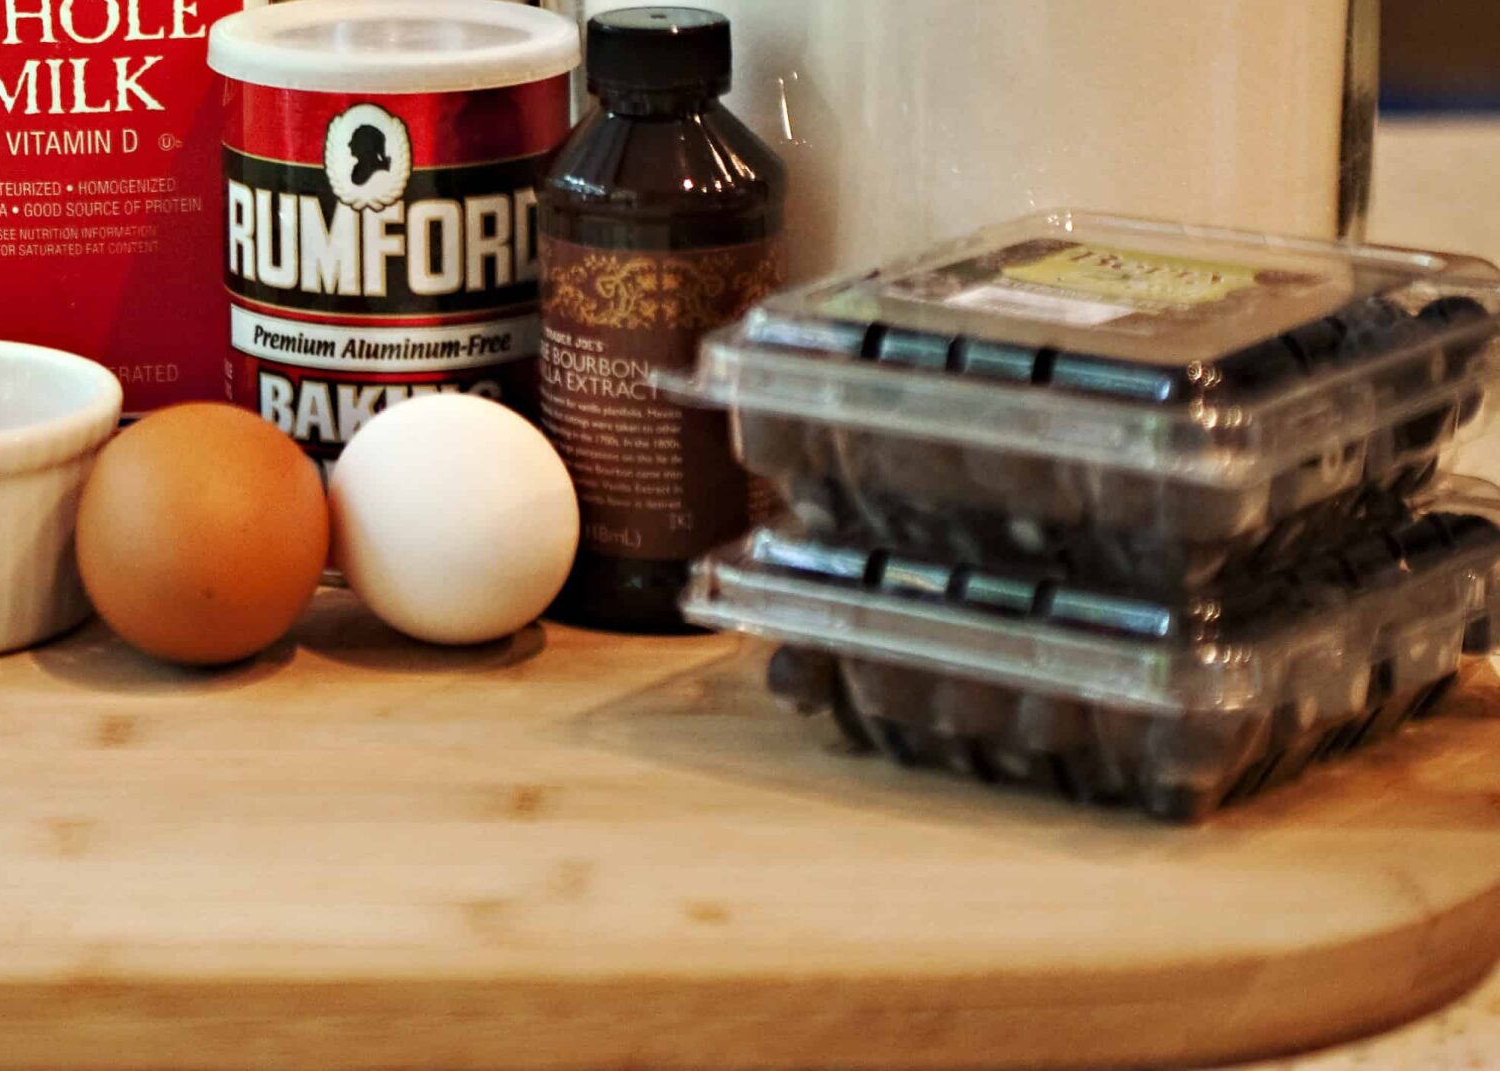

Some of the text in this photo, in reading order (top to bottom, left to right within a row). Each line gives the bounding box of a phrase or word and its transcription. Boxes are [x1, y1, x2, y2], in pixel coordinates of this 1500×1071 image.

[6, 129, 112, 157] VITAMIN
[122, 128, 139, 154] D
[78, 178, 176, 195] HOMOGENIZED
[0, 204, 8, 217] A
[24, 203, 62, 217] GOOD
[66, 201, 120, 217] SOURCE
[124, 200, 141, 215] OF
[145, 197, 202, 214] PROTEIN
[19, 227, 78, 240] NUTRITION
[228, 179, 539, 298] RUMFORD
[18, 243, 83, 256] SATURATED
[86, 242, 104, 255] FAT
[253, 325, 512, 360] Premium Aluminum-Free
[107, 363, 180, 384] RATED
[553, 347, 649, 379] BOURBON
[258, 371, 501, 444] BAK
